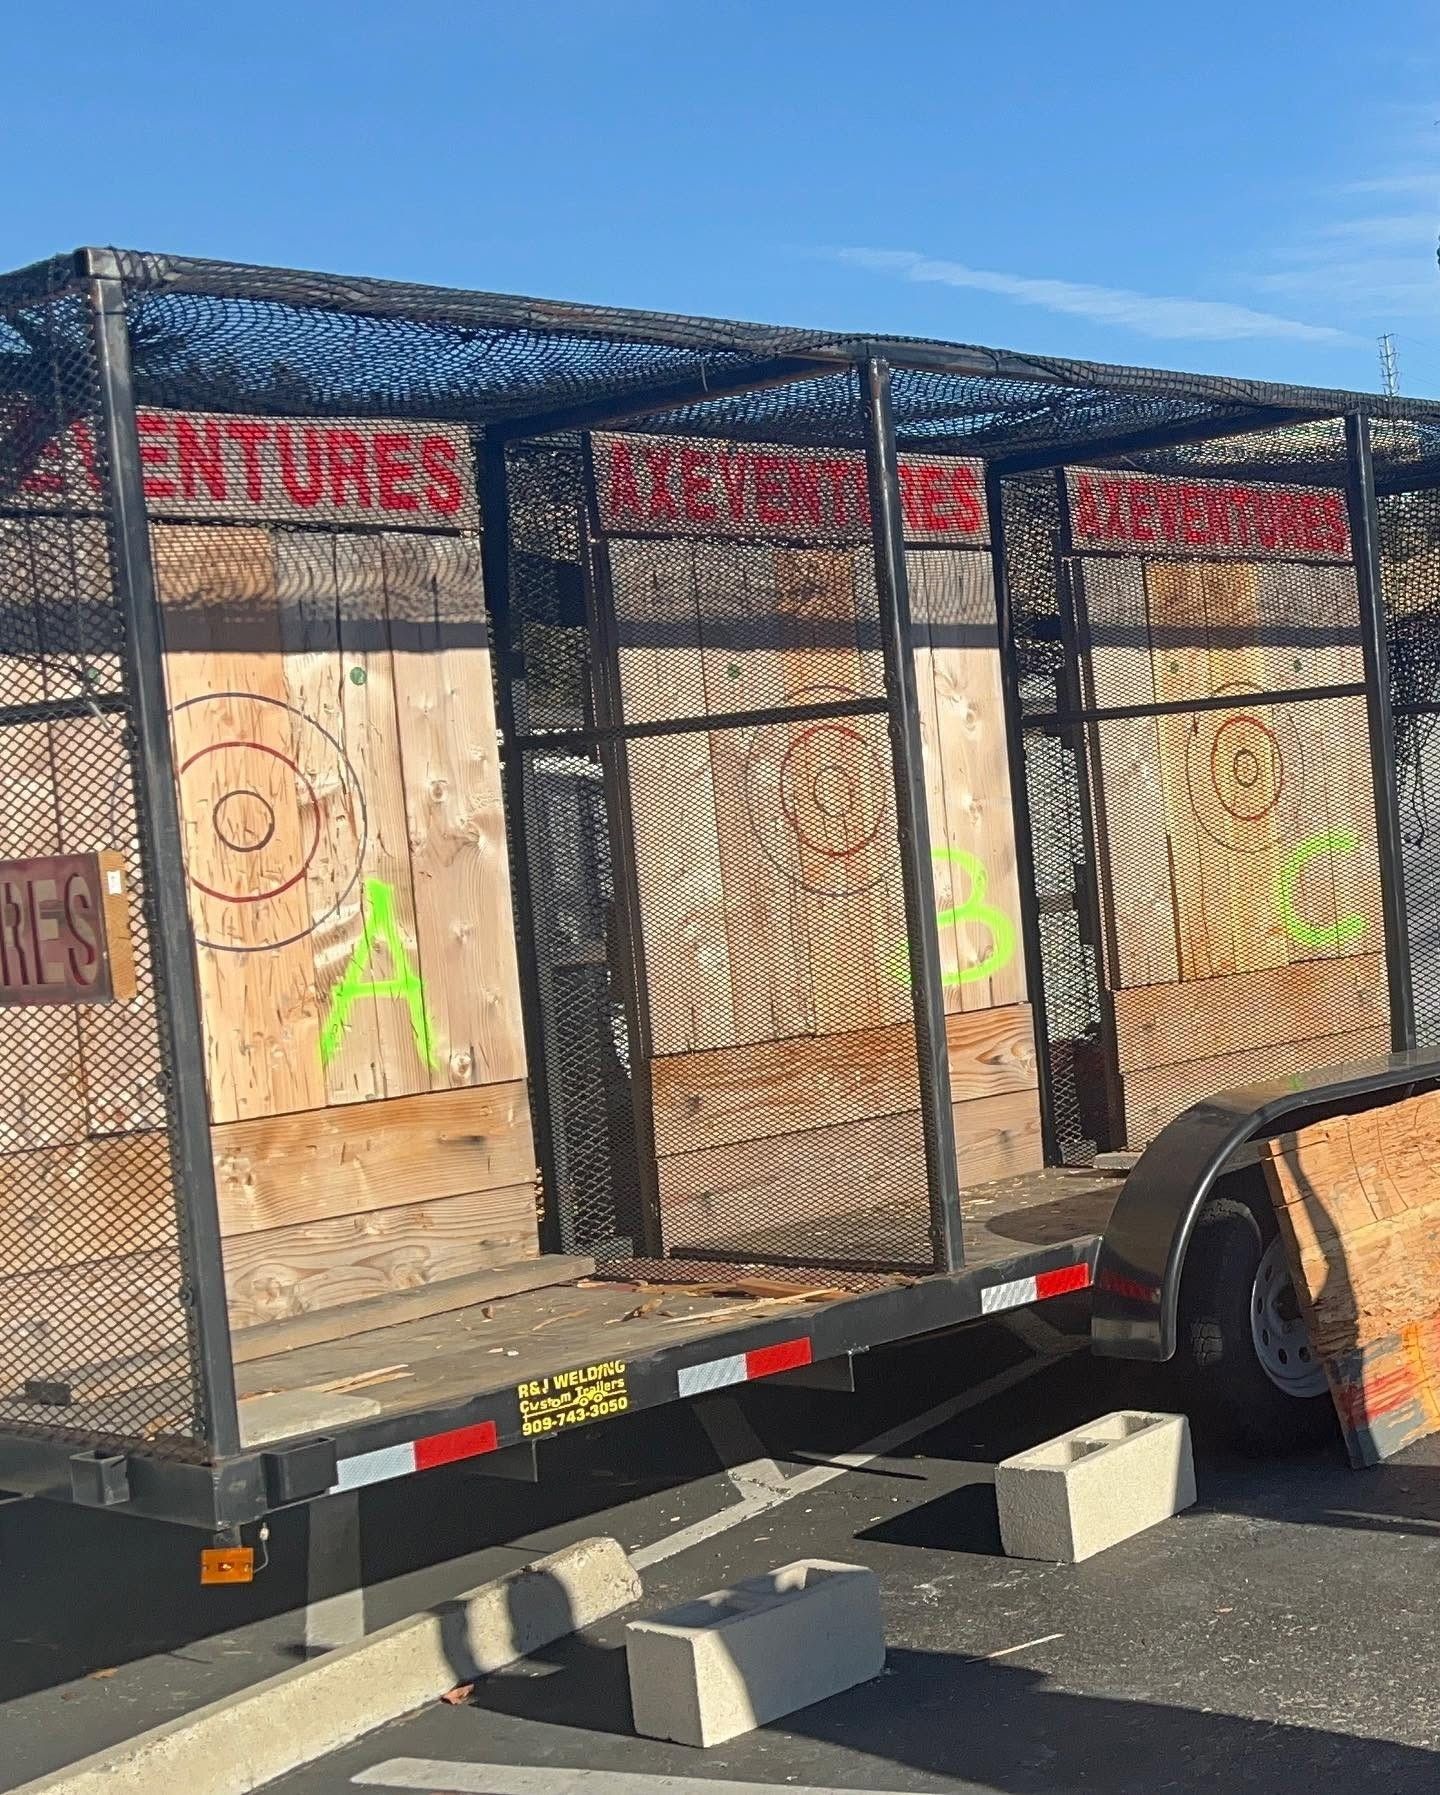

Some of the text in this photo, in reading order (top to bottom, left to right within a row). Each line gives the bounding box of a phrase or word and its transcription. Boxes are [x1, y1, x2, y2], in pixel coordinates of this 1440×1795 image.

[18, 414, 464, 515] ENTURES
[1076, 473, 1347, 553] AXEVENTURES
[892, 846, 1017, 986] B
[1274, 828, 1371, 947] C
[319, 877, 441, 1074] A
[518, 1360, 626, 1399] R&J WELDING
[520, 1378, 625, 1414] Custom Trailers
[522, 1396, 628, 1436] 909-743-3050
